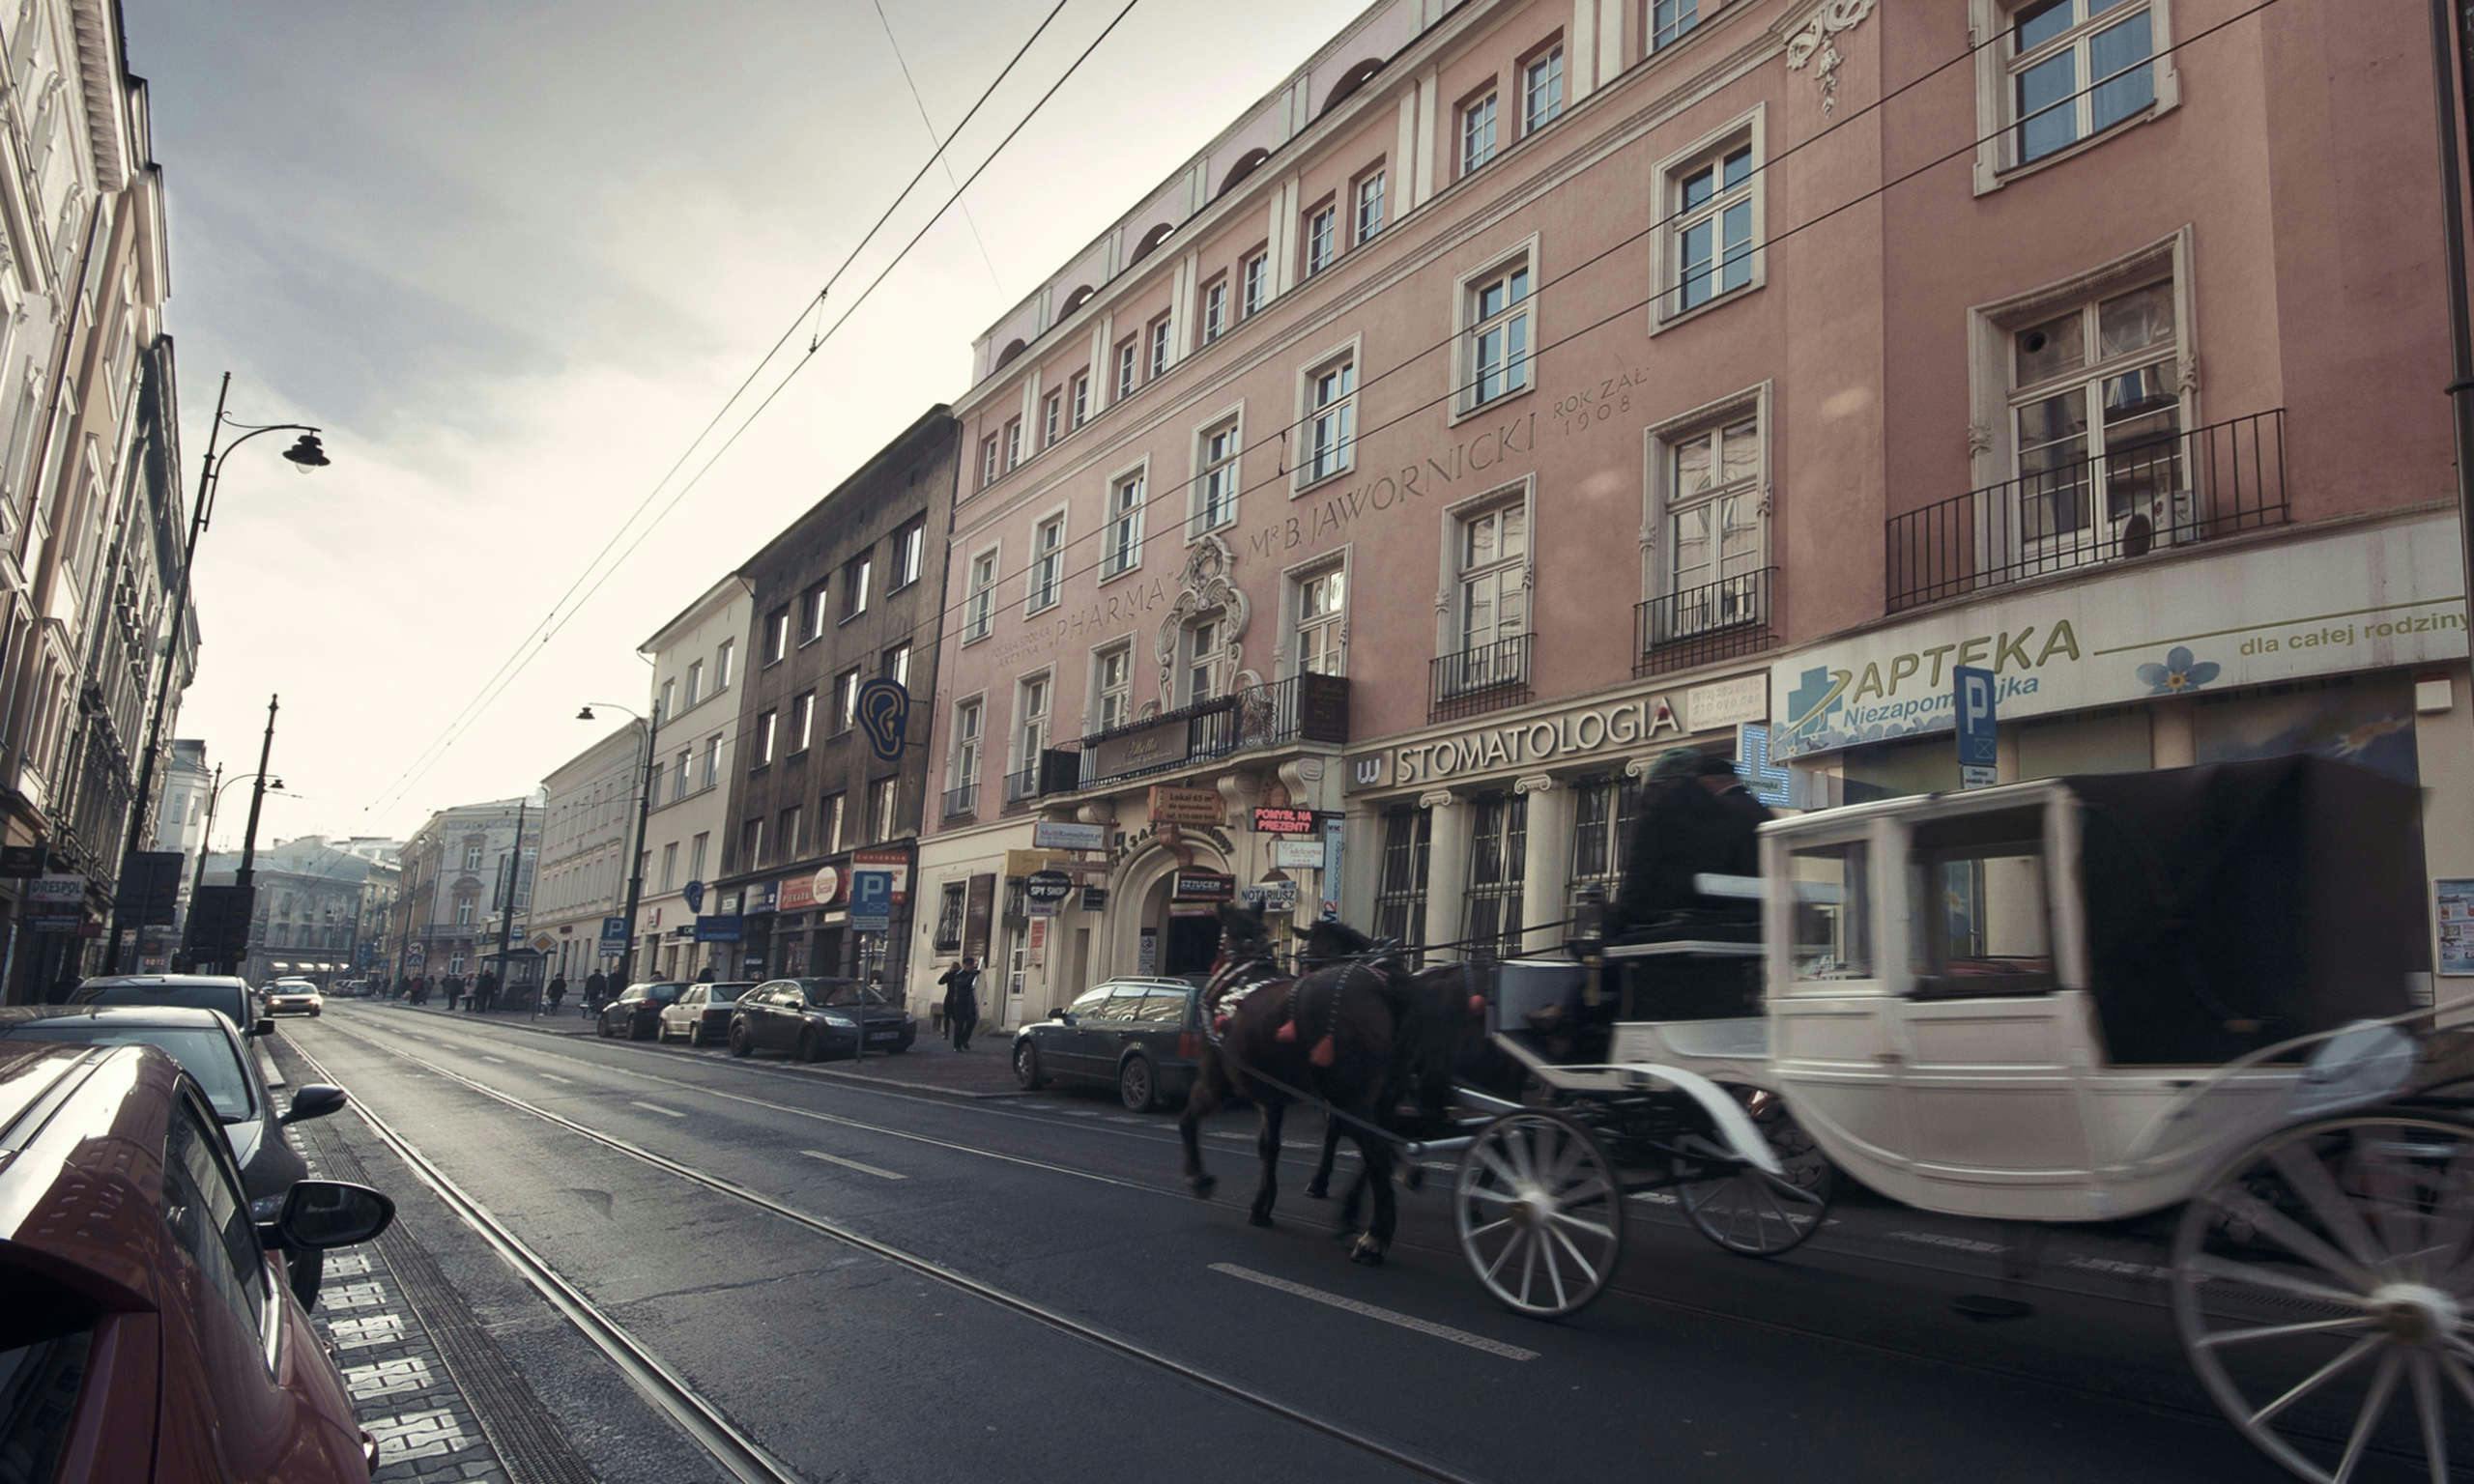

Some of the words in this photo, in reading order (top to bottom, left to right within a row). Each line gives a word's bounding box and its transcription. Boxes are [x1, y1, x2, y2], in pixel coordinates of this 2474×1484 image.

[1553, 388, 1593, 419] ROK
[1565, 395, 1631, 435] 1908
[1310, 413, 1537, 546] JAWORNICKI
[2239, 637, 2280, 656] dla
[2287, 624, 2355, 647] całej
[2364, 612, 2469, 639] rodziny
[1852, 618, 2081, 704] APTEKA
[1842, 675, 2040, 728] Niezapomjka
[1965, 675, 1989, 735] P
[1397, 696, 1680, 783] STOMATOLOGIA
[1258, 819, 1310, 832] PREZENT?
[1298, 810, 1312, 821] NA
[32, 879, 81, 896] DRESPOL
[862, 874, 884, 901] P
[1030, 885, 1046, 897] SPY
[1047, 885, 1067, 897] SHOP
[1241, 889, 1295, 901] NOTARIUSZ
